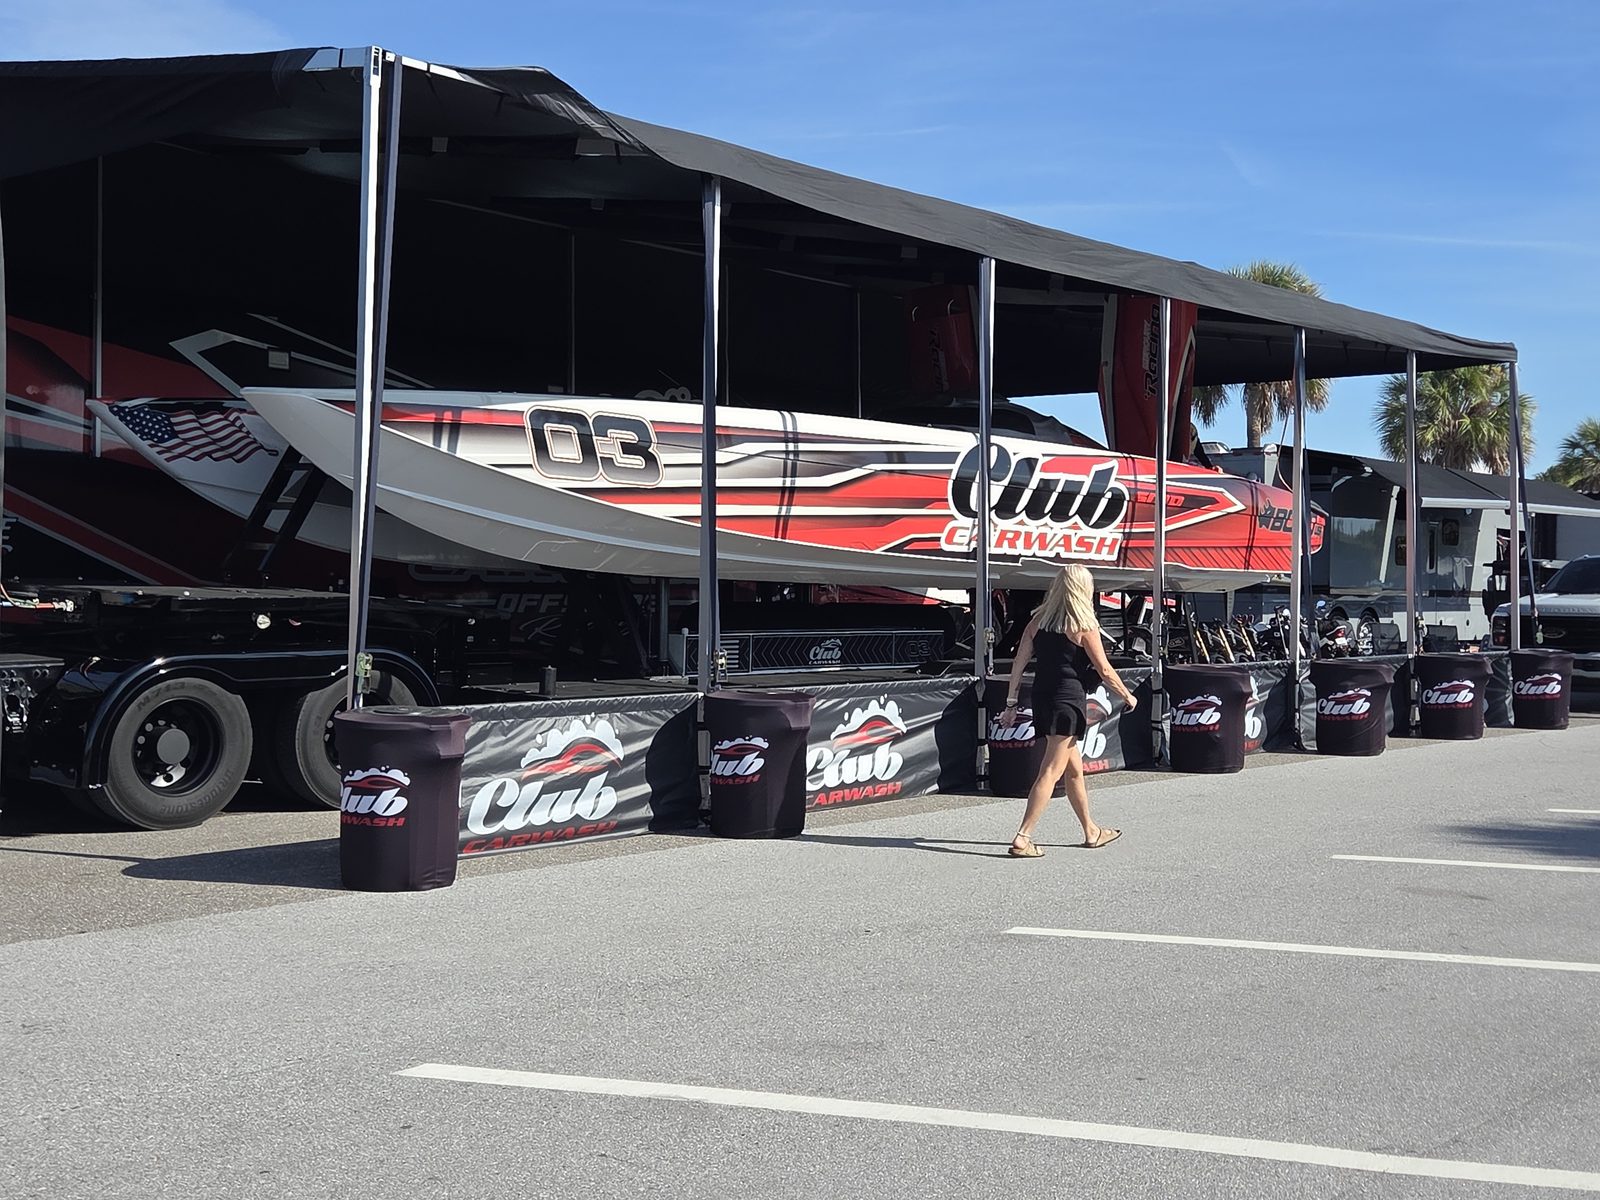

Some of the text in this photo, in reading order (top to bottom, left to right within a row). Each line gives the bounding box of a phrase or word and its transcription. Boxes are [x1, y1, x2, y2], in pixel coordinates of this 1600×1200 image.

[524, 405, 664, 489] 03
[951, 442, 1127, 530] Club
[944, 525, 1121, 556] CRWASH
[809, 645, 842, 660] Club
[1422, 688, 1475, 704] Club
[1514, 680, 1562, 695] Club
[1317, 697, 1371, 715] Club
[710, 748, 766, 777] lub
[805, 740, 904, 791] Club
[340, 782, 409, 817] lub
[466, 771, 618, 835] Club
[341, 814, 406, 827] WASH
[462, 820, 619, 854] CARWASH
